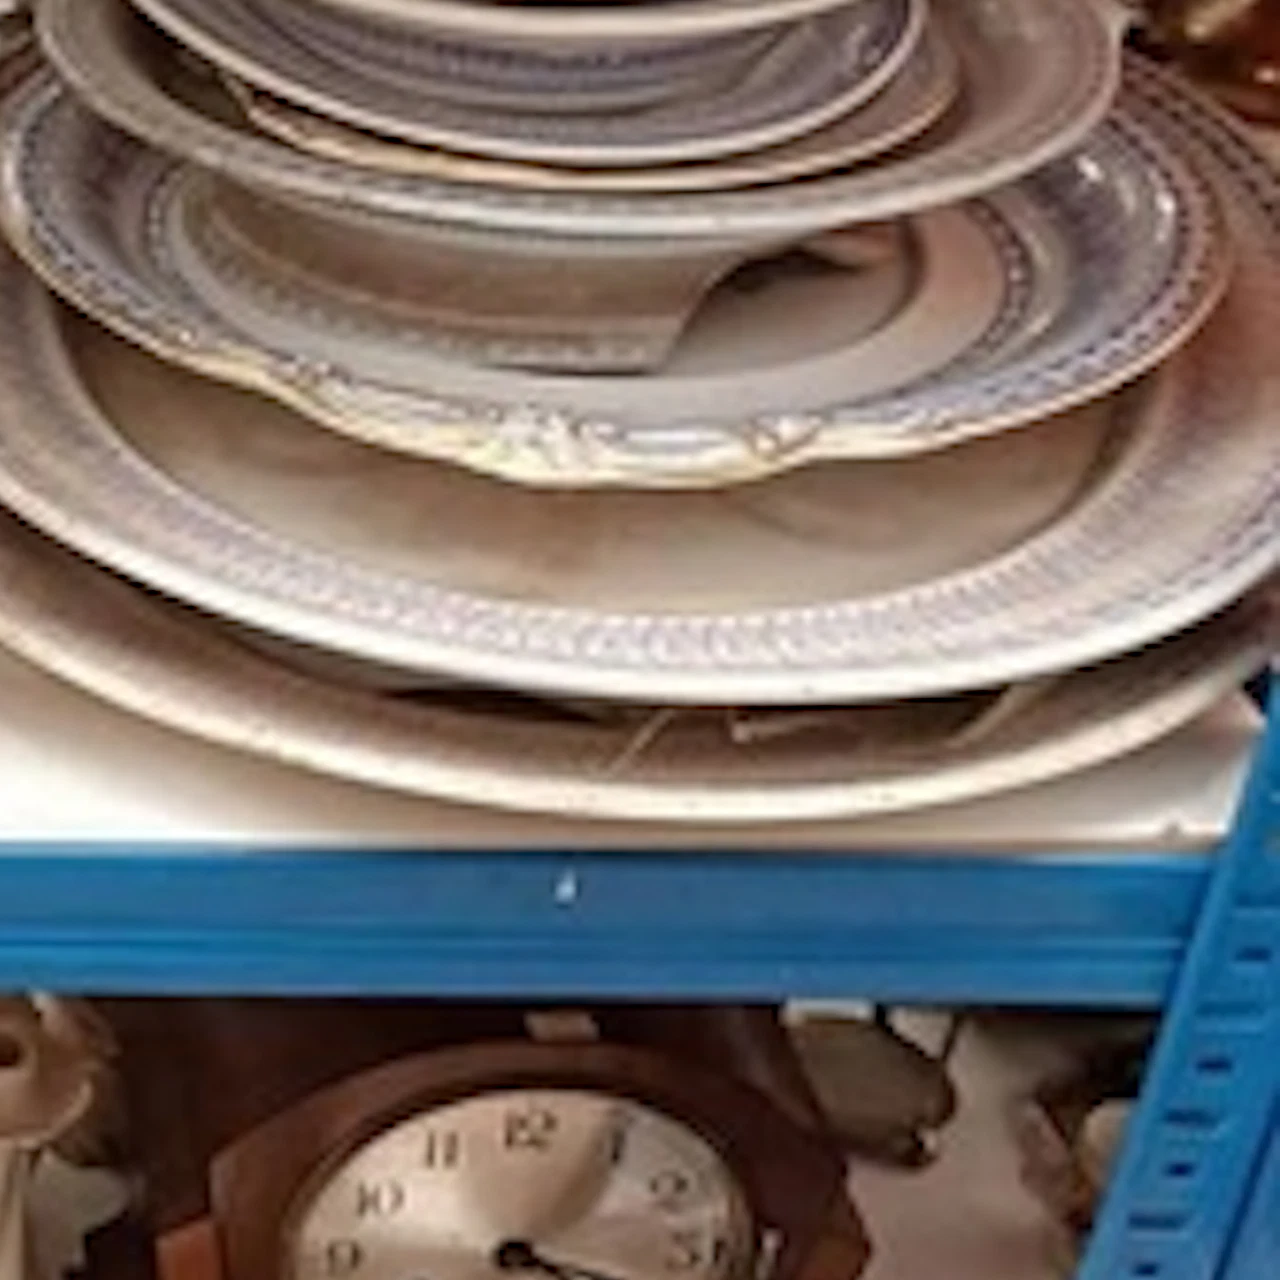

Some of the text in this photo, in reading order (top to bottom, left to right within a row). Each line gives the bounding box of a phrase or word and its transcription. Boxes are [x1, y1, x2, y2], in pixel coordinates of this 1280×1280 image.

[504, 1111, 558, 1151] 12
[425, 1132, 460, 1169] 11
[357, 1180, 404, 1218] 10
